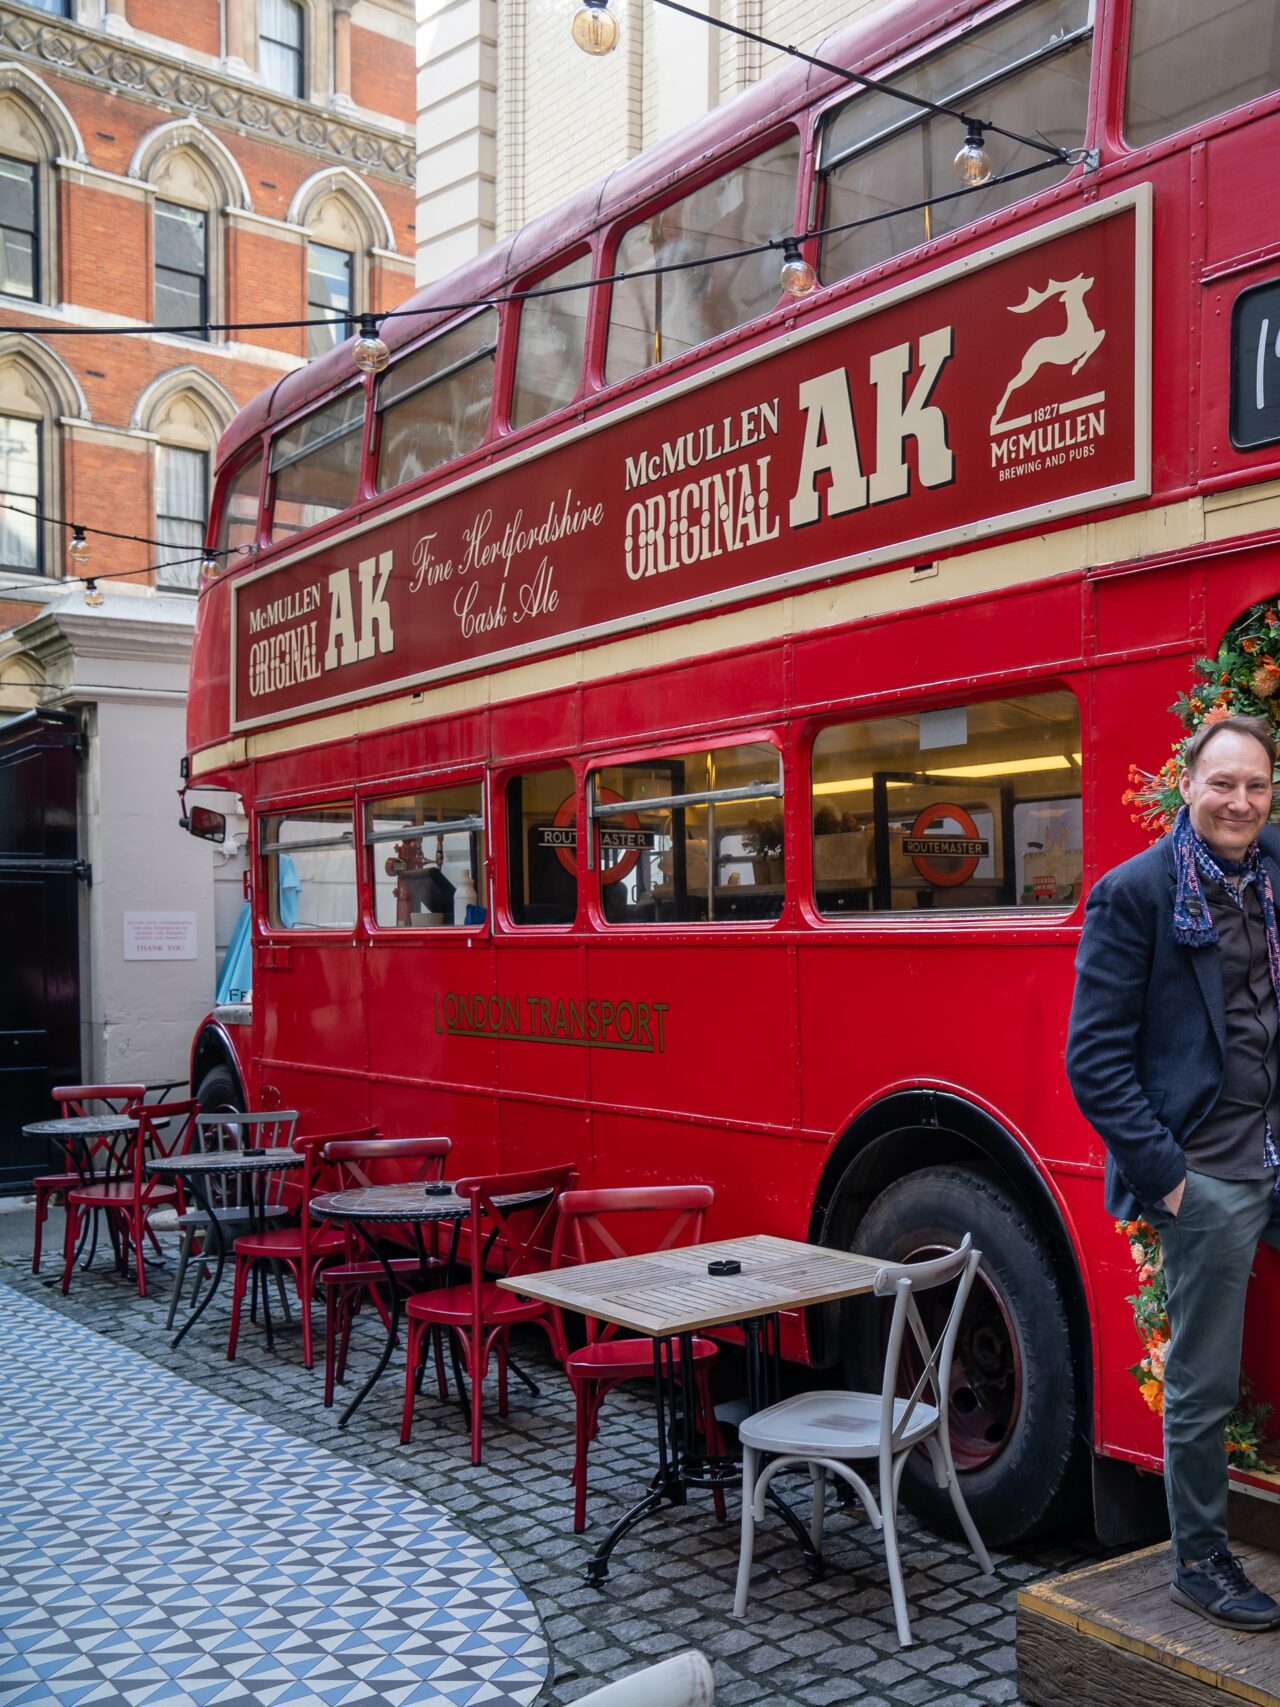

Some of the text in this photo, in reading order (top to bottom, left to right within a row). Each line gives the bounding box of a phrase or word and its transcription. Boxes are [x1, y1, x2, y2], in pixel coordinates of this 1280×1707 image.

[624, 397, 780, 492] McMULLEN
[788, 326, 956, 530] AK
[990, 408, 1105, 468] McMULLEN
[1033, 402, 1059, 424] 1827
[999, 443, 1095, 482] BREWING AND PUBS
[409, 488, 605, 593] Fine Hertfordshire
[624, 454, 780, 582] ORIGINAL
[249, 582, 322, 635] McMULLEN
[324, 549, 394, 672] AK
[453, 554, 560, 639] Cask Ale
[249, 619, 322, 698] ORIGINAL
[907, 841, 983, 855] ROUTEMASTER
[433, 990, 669, 1054] LONDON TRANSPORT
